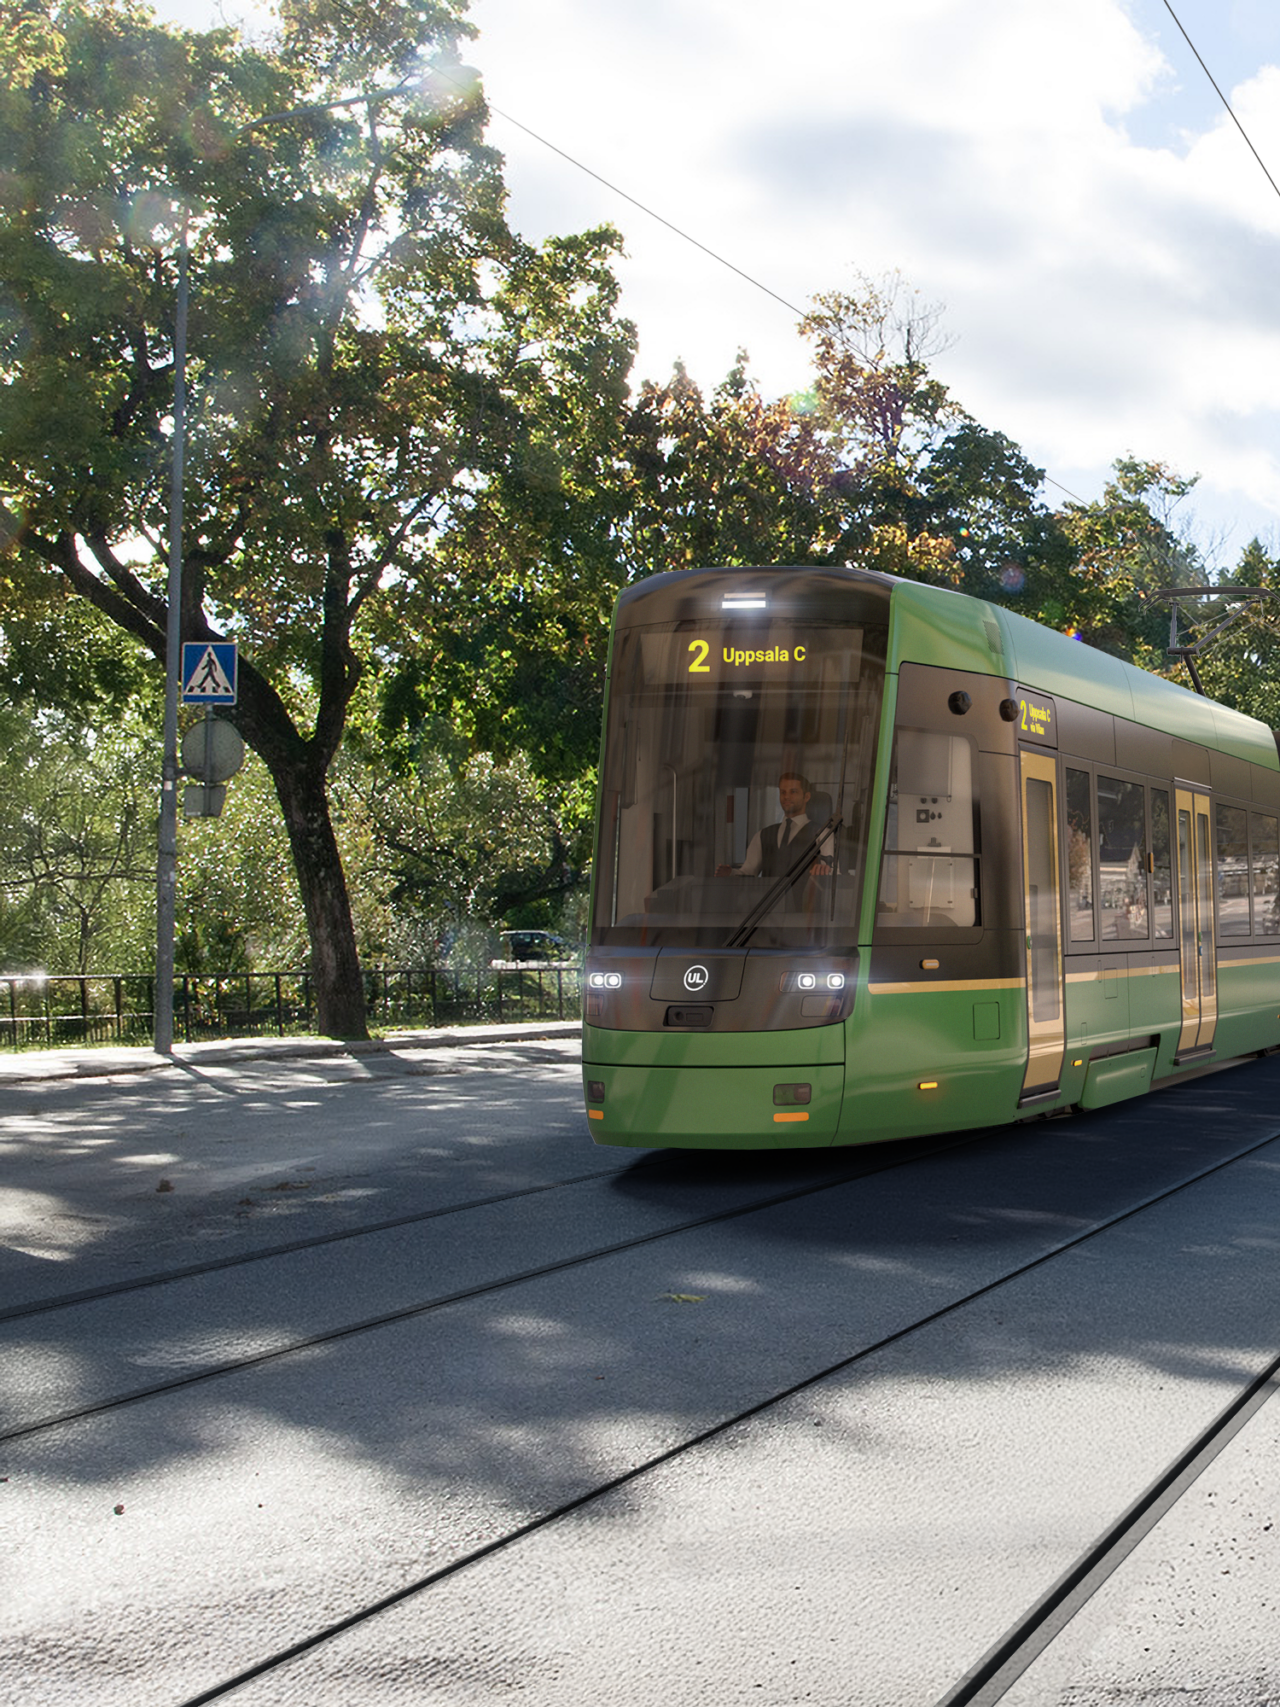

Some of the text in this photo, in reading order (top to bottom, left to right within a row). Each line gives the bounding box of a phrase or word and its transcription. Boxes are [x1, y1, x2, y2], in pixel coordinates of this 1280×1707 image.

[688, 640, 806, 672] 2 Uppsala C
[1020, 700, 1028, 731] 2
[1047, 709, 1051, 722] C
[688, 973, 703, 983] UL
